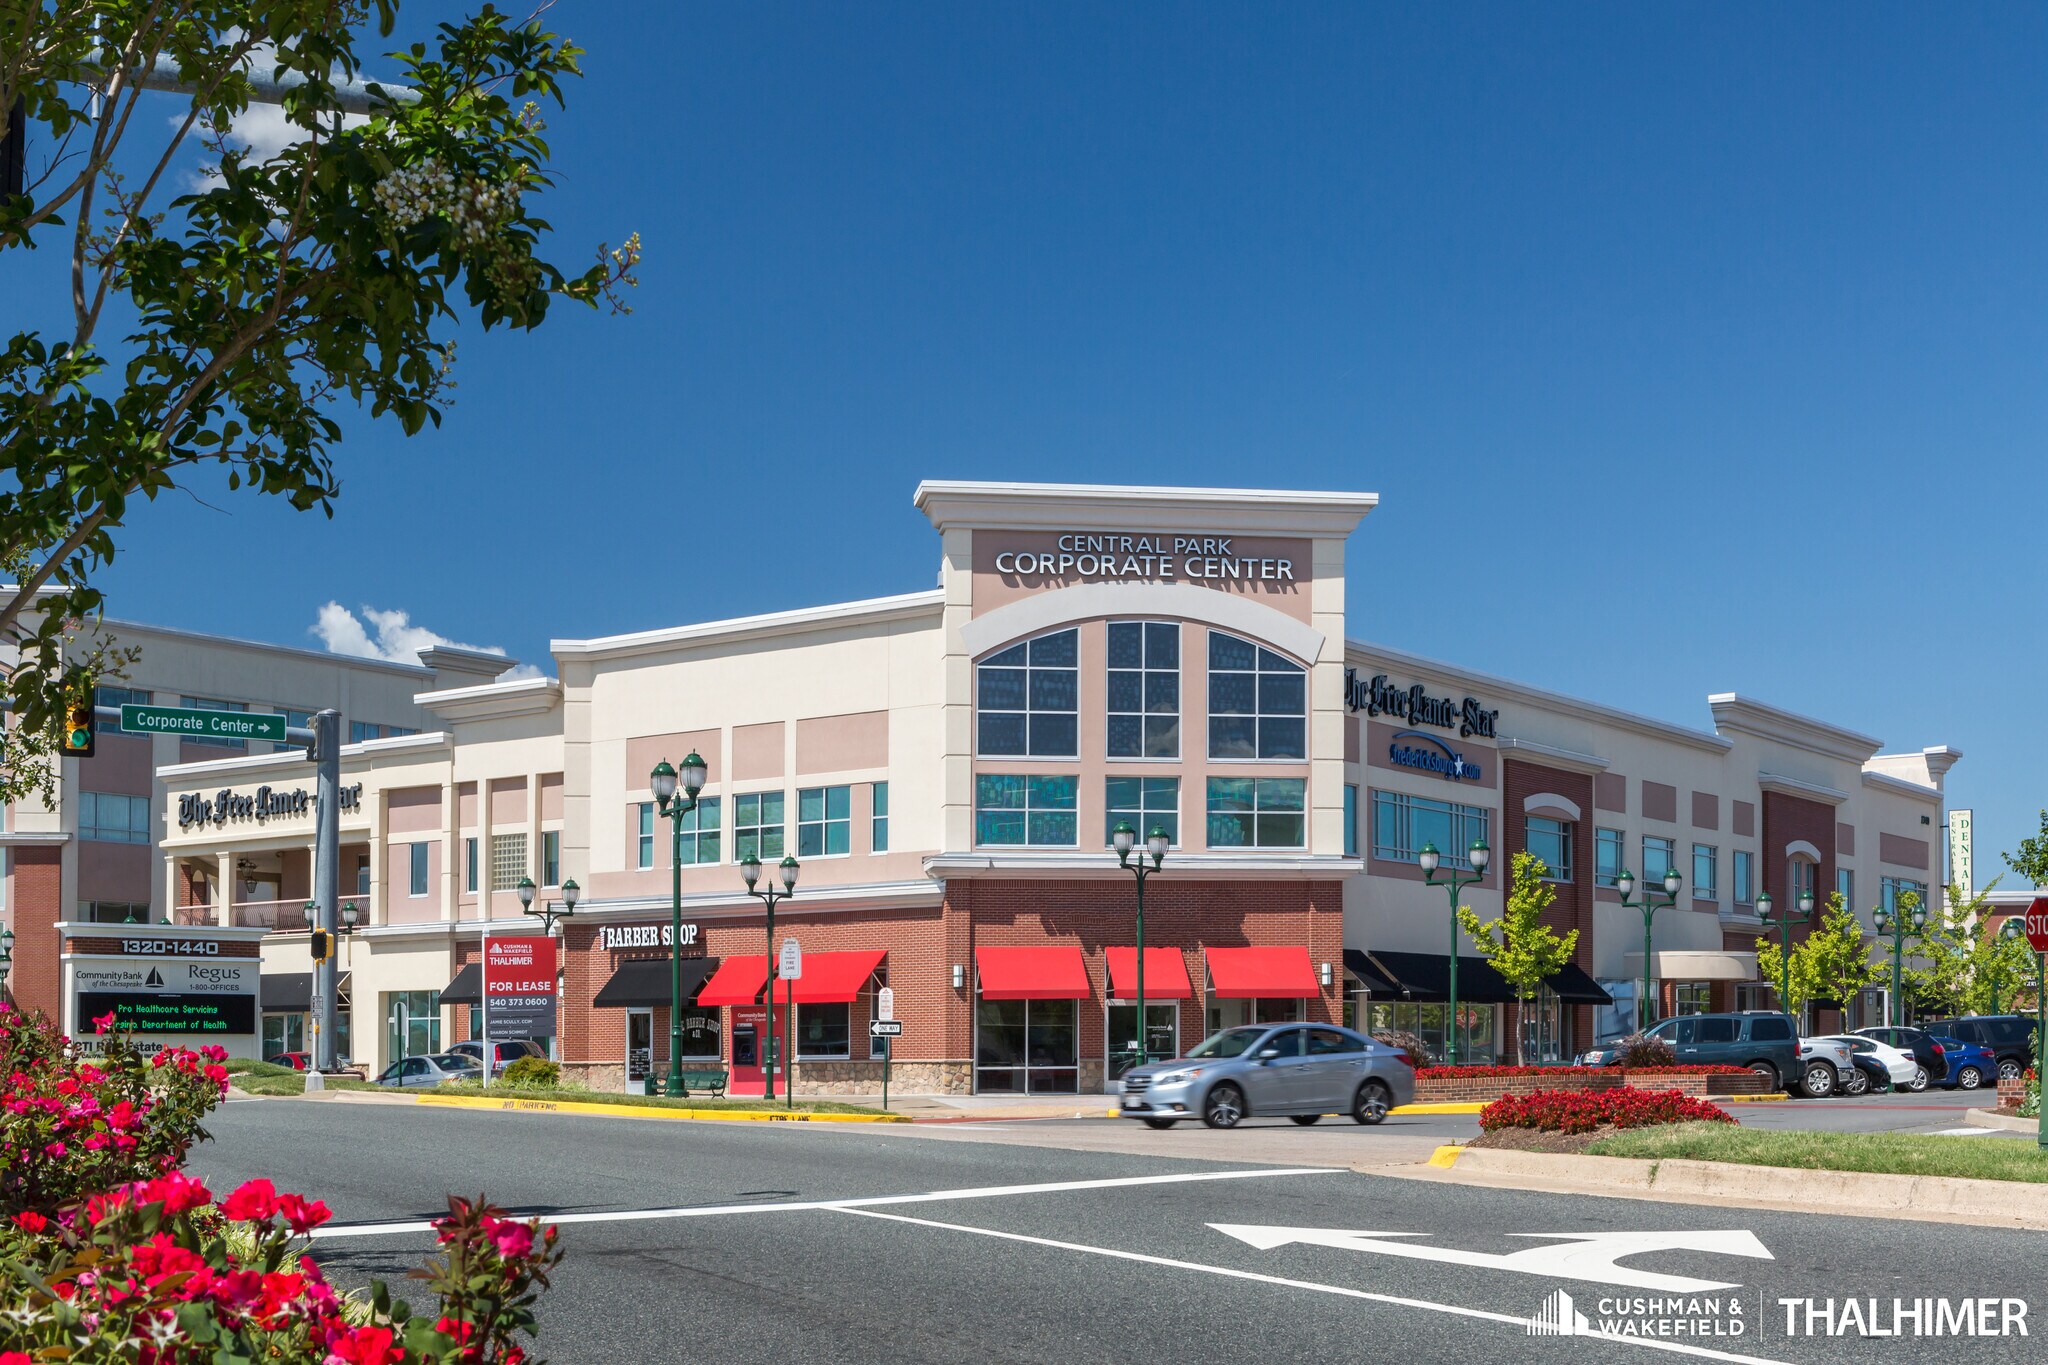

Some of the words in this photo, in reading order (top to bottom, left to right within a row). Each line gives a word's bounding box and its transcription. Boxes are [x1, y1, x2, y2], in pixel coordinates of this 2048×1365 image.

[1058, 535, 1167, 554] CENTRAL
[1173, 538, 1233, 556] PARK
[995, 551, 1174, 577] CORPORATE
[1184, 556, 1294, 580] CENTER
[1367, 675, 1409, 717] Free
[137, 712, 203, 730] Corporate
[211, 717, 254, 733] Center
[179, 793, 212, 827] The
[213, 789, 254, 823] Free
[255, 782, 363, 819] Lance-ar
[1960, 819, 1970, 891] DENTAL
[2028, 915, 2048, 935] STO
[606, 926, 660, 948] BARBER
[662, 924, 698, 946] SOP
[122, 940, 219, 954] 1320-1440
[489, 957, 533, 966] THALHIMER
[76, 971, 122, 981] Community
[123, 971, 143, 980] Bank
[189, 964, 240, 983] Regus
[190, 984, 240, 992] 1-800-OFFICES
[489, 982, 513, 992] FOR
[516, 981, 551, 991] LEASE
[118, 1004, 132, 1013] Pro
[136, 1004, 179, 1013] Healthcare
[182, 1004, 218, 1014] Servicing
[508, 998, 523, 1006] 373
[525, 998, 548, 1006] 0600
[142, 1020, 187, 1029] Department
[190, 1020, 199, 1029] of
[203, 1020, 227, 1029] Health
